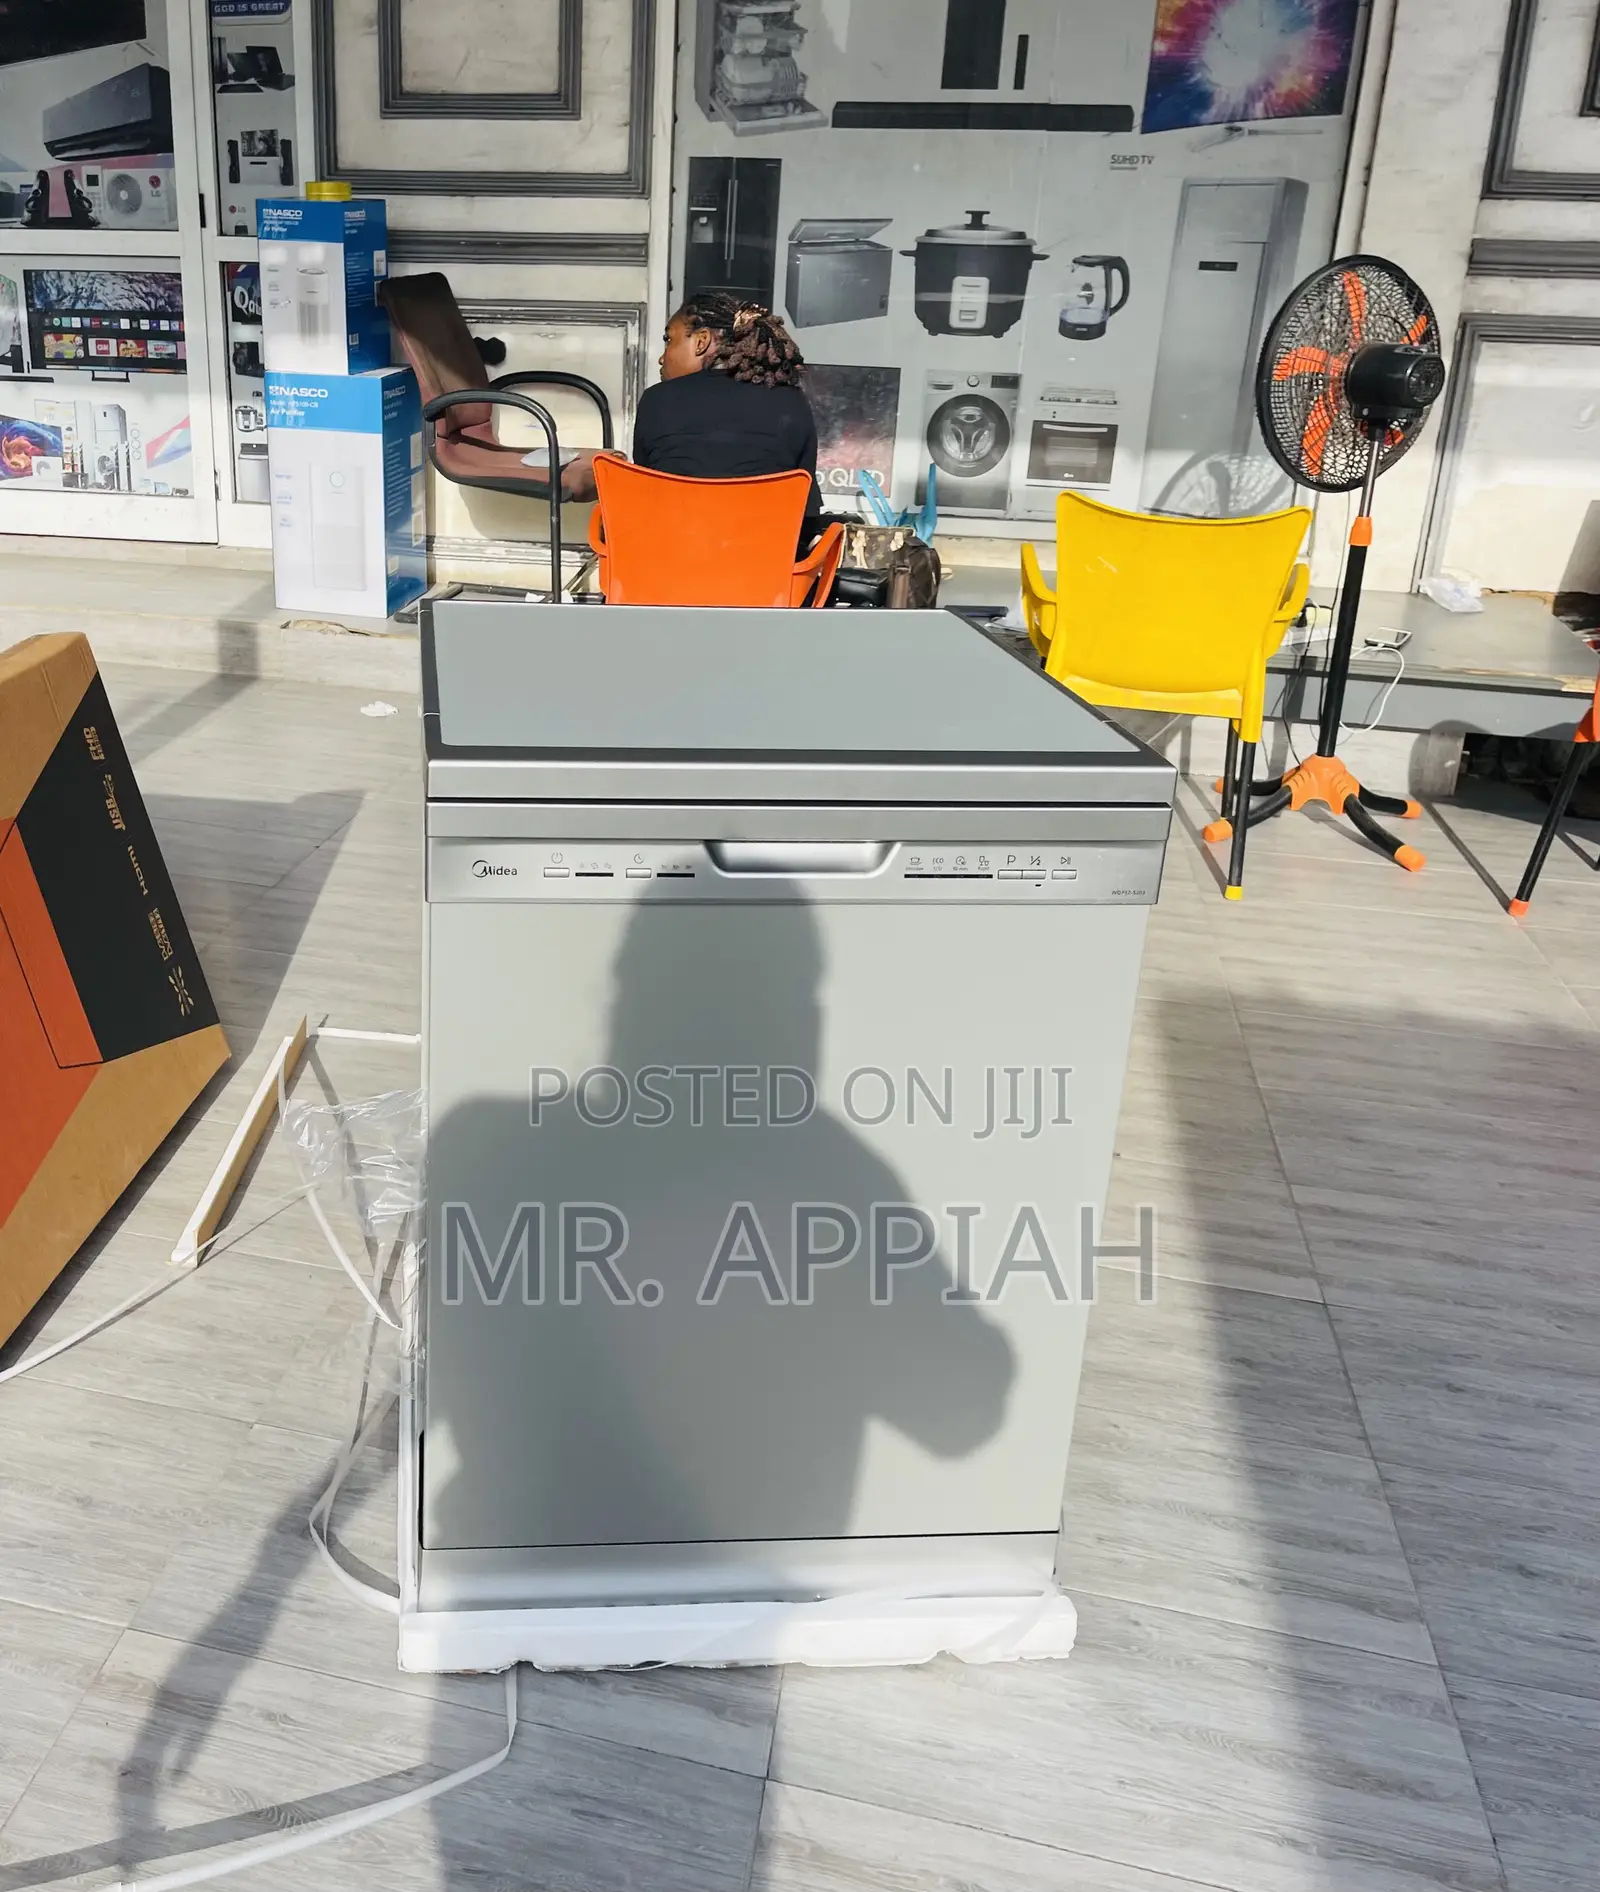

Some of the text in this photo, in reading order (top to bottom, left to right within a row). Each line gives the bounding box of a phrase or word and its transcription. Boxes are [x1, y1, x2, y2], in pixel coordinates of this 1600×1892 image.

[214, 2, 286, 13] GOD IS GREAT
[1140, 154, 1155, 165] TV
[269, 208, 303, 217] NASCO
[279, 386, 329, 398] NASCO
[829, 467, 885, 488] QLD
[105, 798, 124, 830] USB
[1006, 854, 1017, 866] P
[472, 860, 518, 878] Midea
